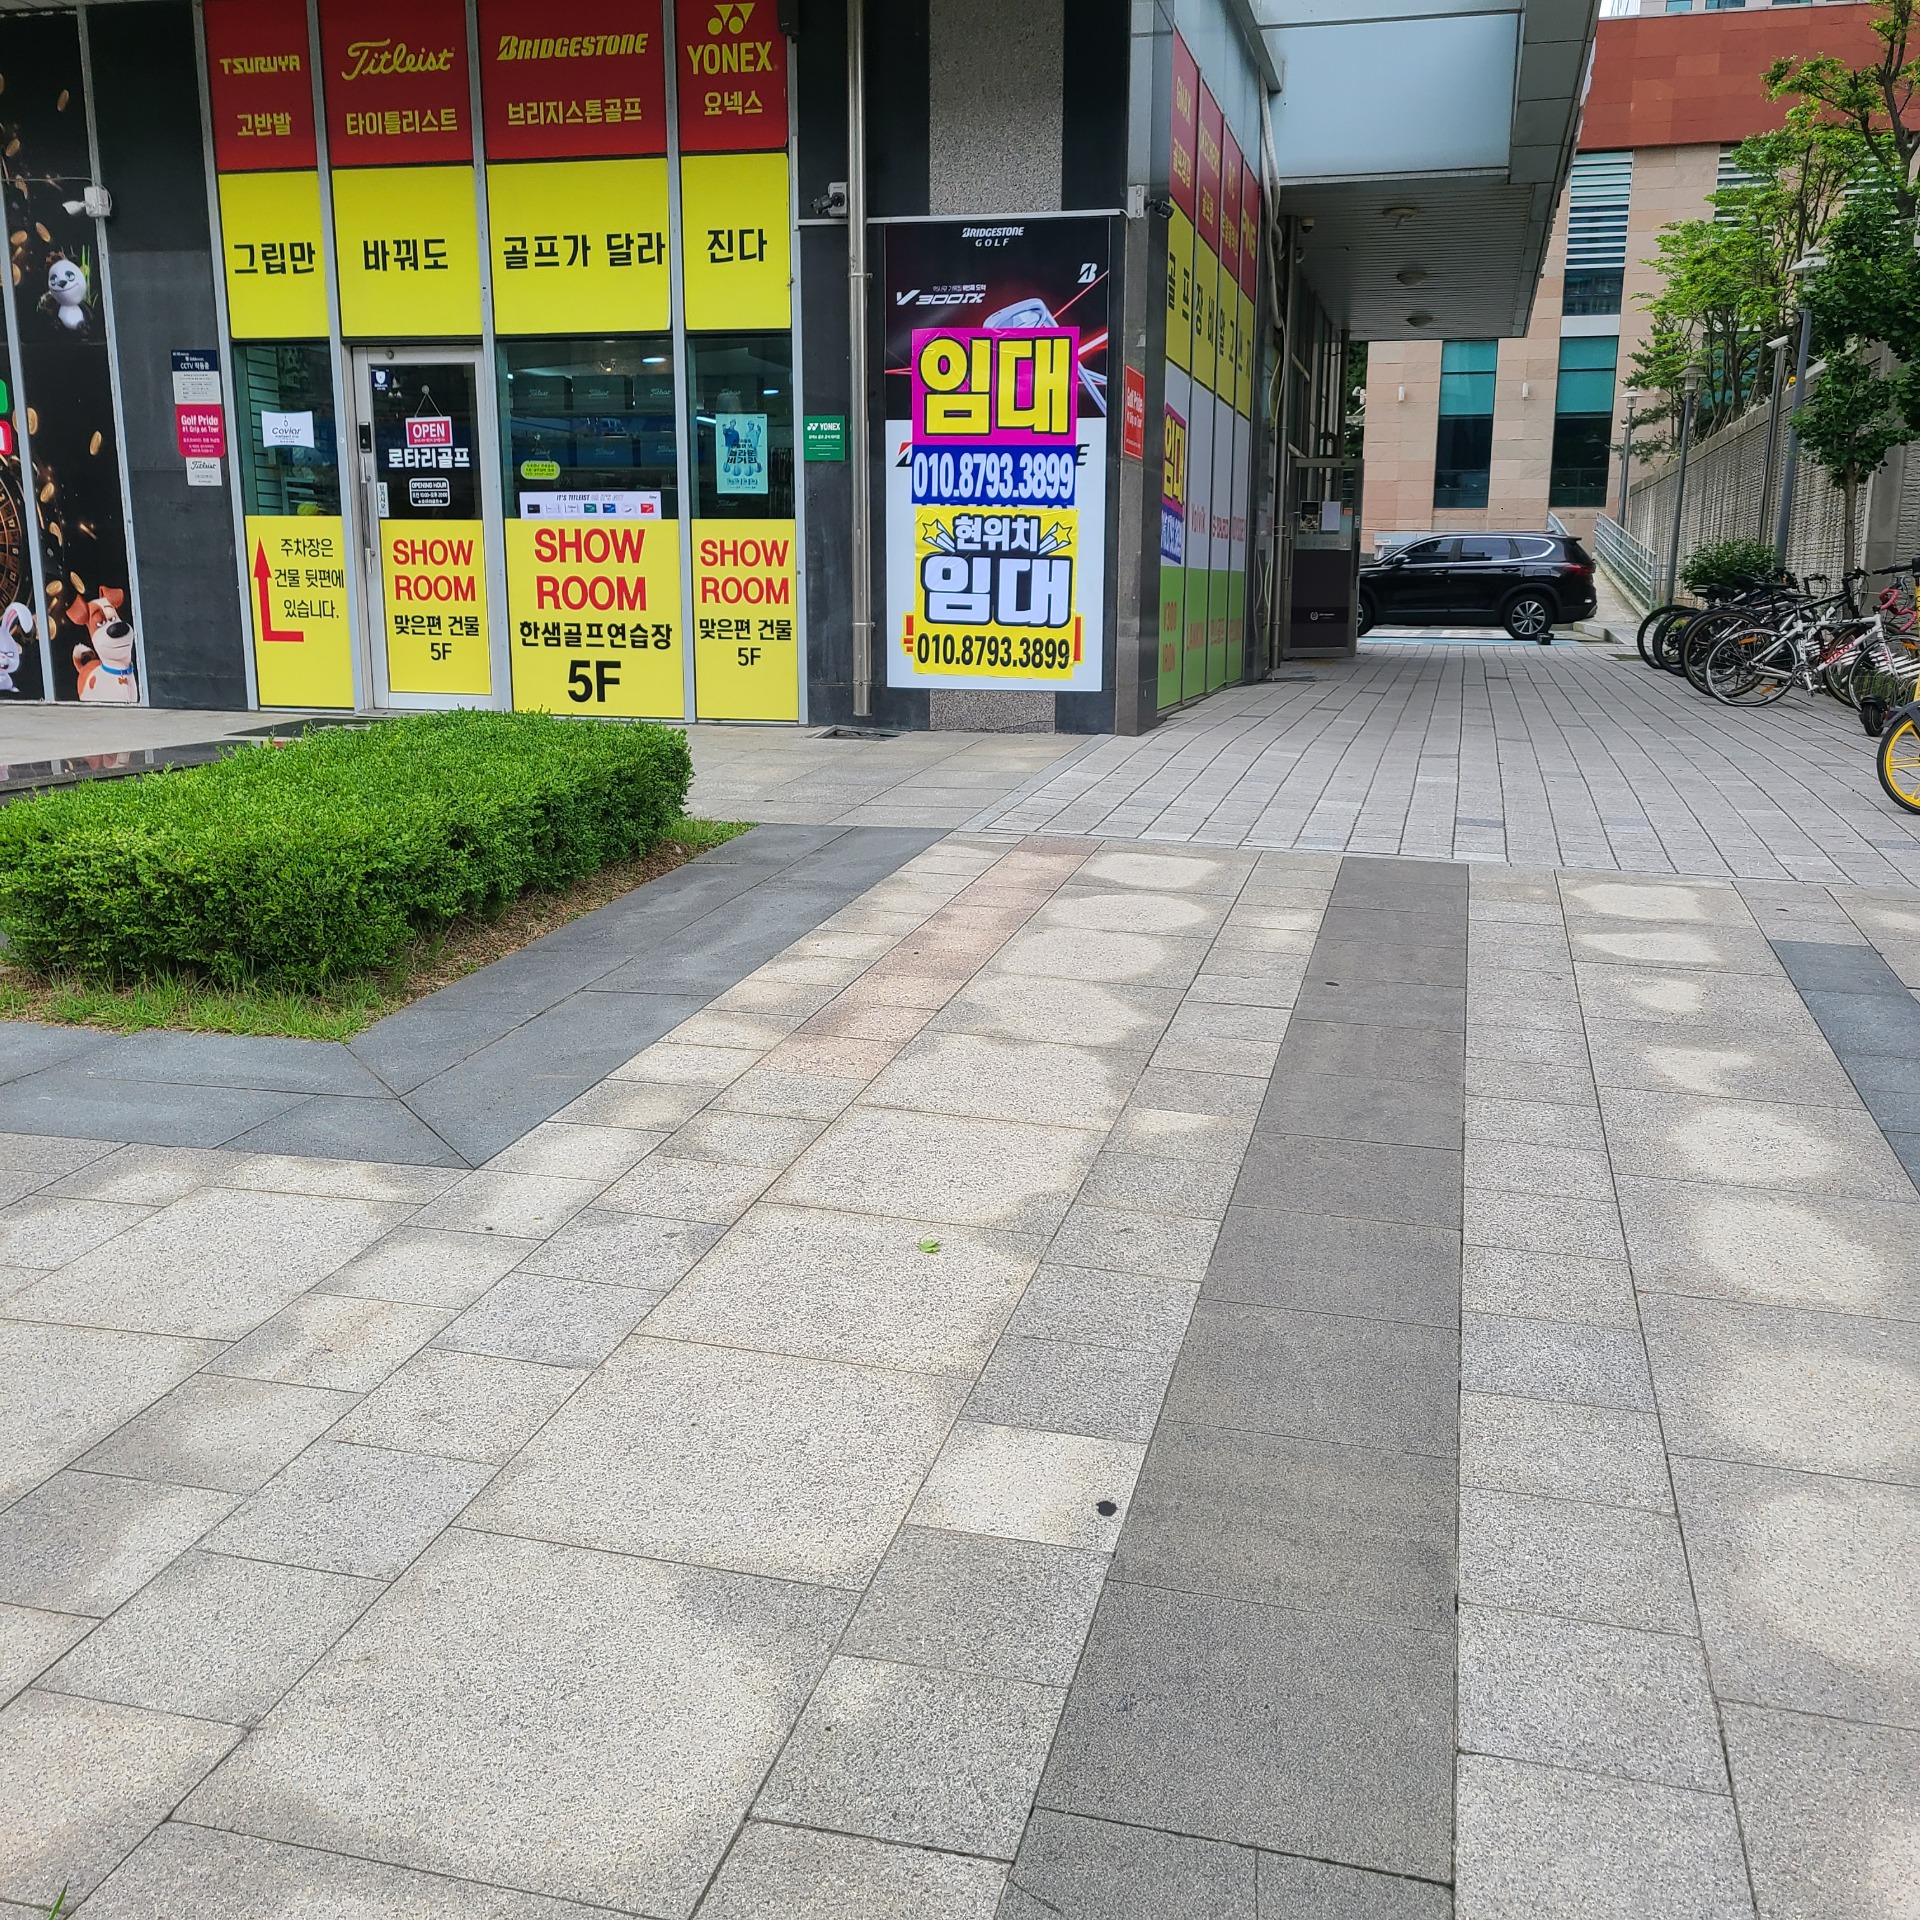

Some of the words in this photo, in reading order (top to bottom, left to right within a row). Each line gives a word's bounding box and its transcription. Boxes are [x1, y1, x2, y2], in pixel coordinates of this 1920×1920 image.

[341, 39, 454, 81] Titleist
[496, 33, 649, 61] BRIDGESTONE
[686, 41, 774, 75] YONEX
[219, 55, 301, 75] TSURUYA
[507, 98, 643, 127] 브리지스톤골프
[703, 90, 763, 116] 요넥스
[236, 112, 292, 137] 고반발
[346, 108, 458, 136] 타이틀리스트
[962, 227, 1024, 238] BRIDGESTONE
[975, 238, 1009, 247] GOLF
[233, 241, 316, 275] 그립만
[362, 238, 449, 272] 바꿔도
[503, 234, 591, 270] 골프가
[606, 231, 666, 267] 달라
[706, 228, 768, 264] 진다
[180, 362, 194, 370] CCTV
[919, 335, 1072, 435] 임대
[181, 415, 197, 426] Golf
[198, 415, 219, 426] Pride
[272, 427, 302, 435] Caviar
[412, 423, 445, 438] OPEN
[819, 422, 841, 431] YONEX
[388, 448, 471, 469] 로타리골프
[433, 481, 447, 489] HOUR
[913, 452, 1075, 499] 010.8793.3899
[534, 528, 646, 564] SHOW
[953, 514, 1041, 553] 현위치
[280, 537, 334, 558] 주차장은
[392, 539, 474, 567] SHOW
[700, 539, 789, 568] SHOW
[274, 569, 300, 589] 건물
[305, 568, 345, 589] 뒷편에
[395, 575, 476, 603] ROOM
[700, 576, 790, 605] ROOM
[922, 554, 1073, 628] 임대
[536, 575, 647, 612] ROOM
[283, 599, 340, 619] 있습니다.
[394, 615, 443, 637] 맞은편
[448, 614, 480, 636] 건물
[519, 621, 673, 650] 한샘골프연습장
[699, 619, 752, 641] 맞은편
[757, 618, 793, 641] 건물
[430, 642, 452, 661] 5F
[737, 647, 762, 667] 5F
[917, 633, 1071, 669] 010.8793.3899
[567, 659, 622, 703] 5F
